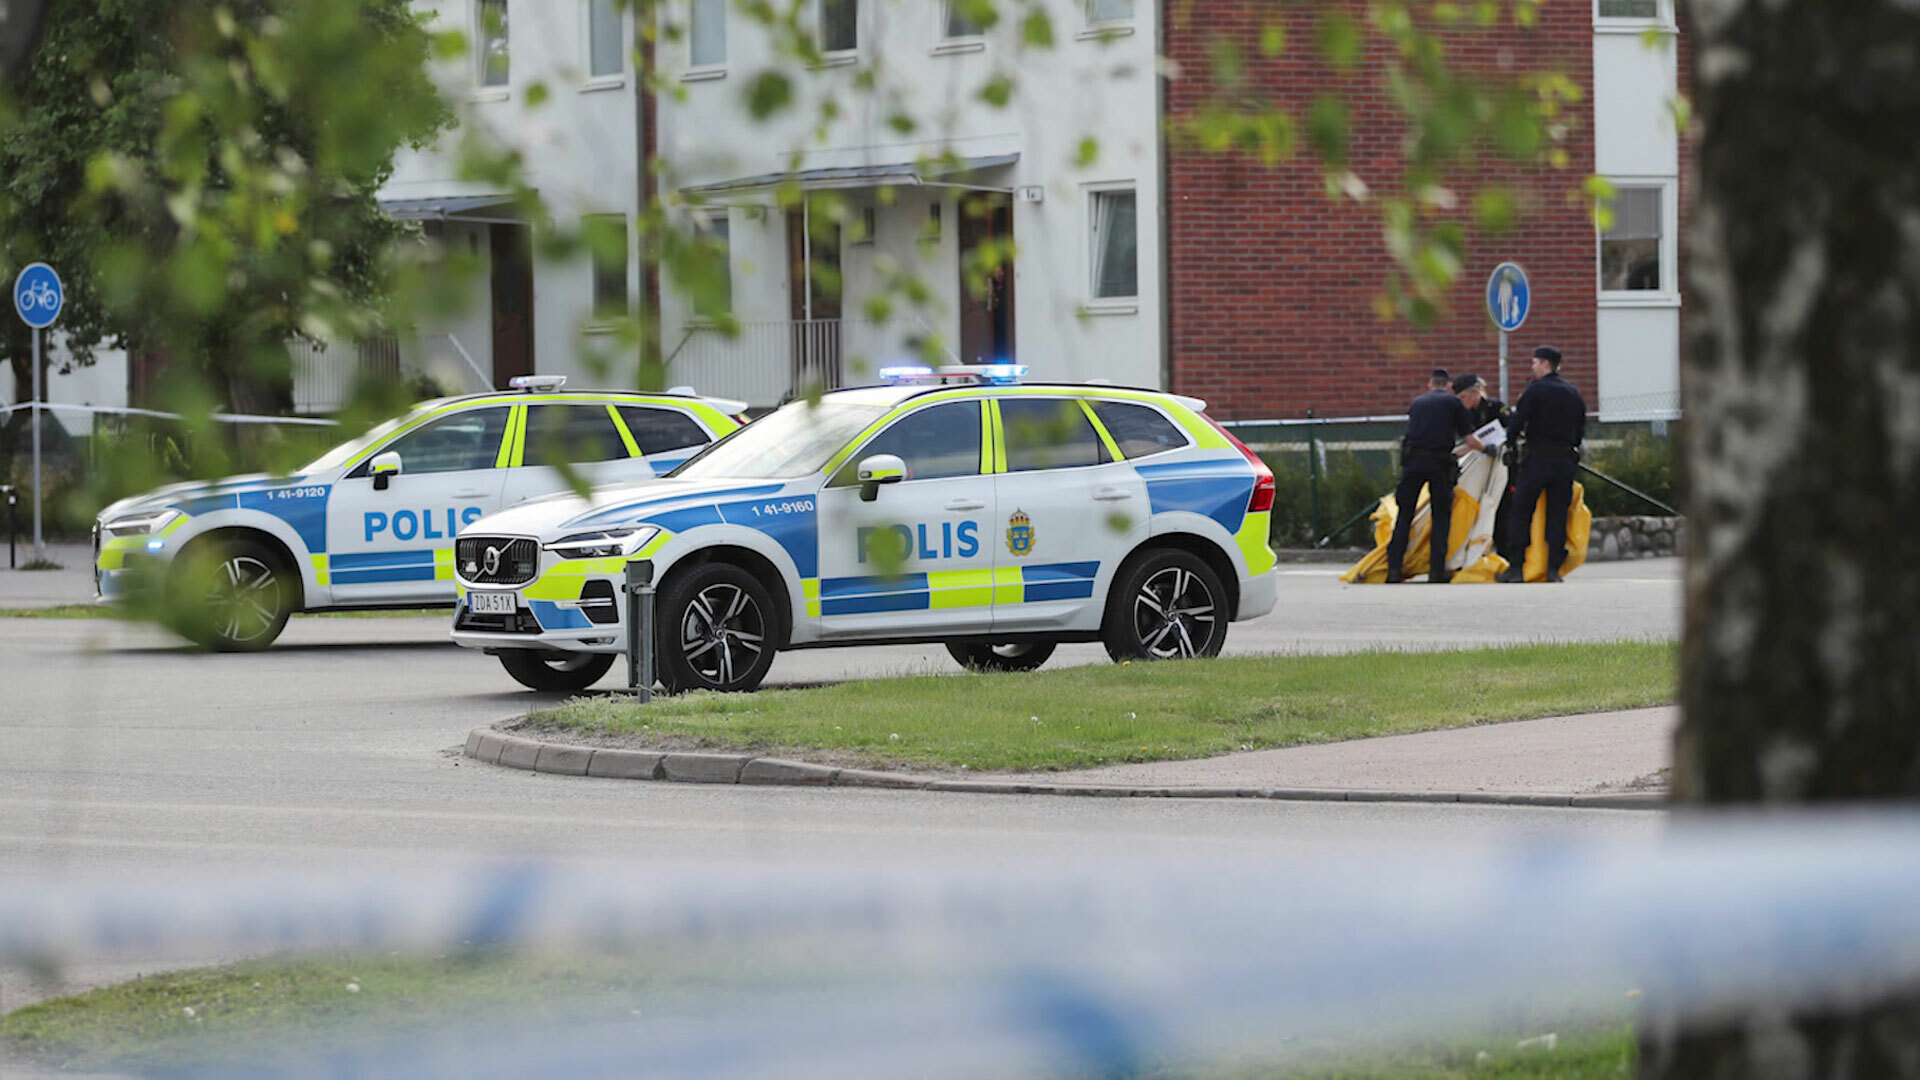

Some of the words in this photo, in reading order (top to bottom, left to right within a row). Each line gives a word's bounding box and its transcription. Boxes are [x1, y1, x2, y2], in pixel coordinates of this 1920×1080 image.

[267, 491, 273, 500] 1
[278, 487, 326, 499] 41-9120
[752, 506, 760, 517] 1
[764, 500, 814, 515] 41-9160
[857, 520, 979, 564] POLIS
[493, 595, 512, 612] 51X
